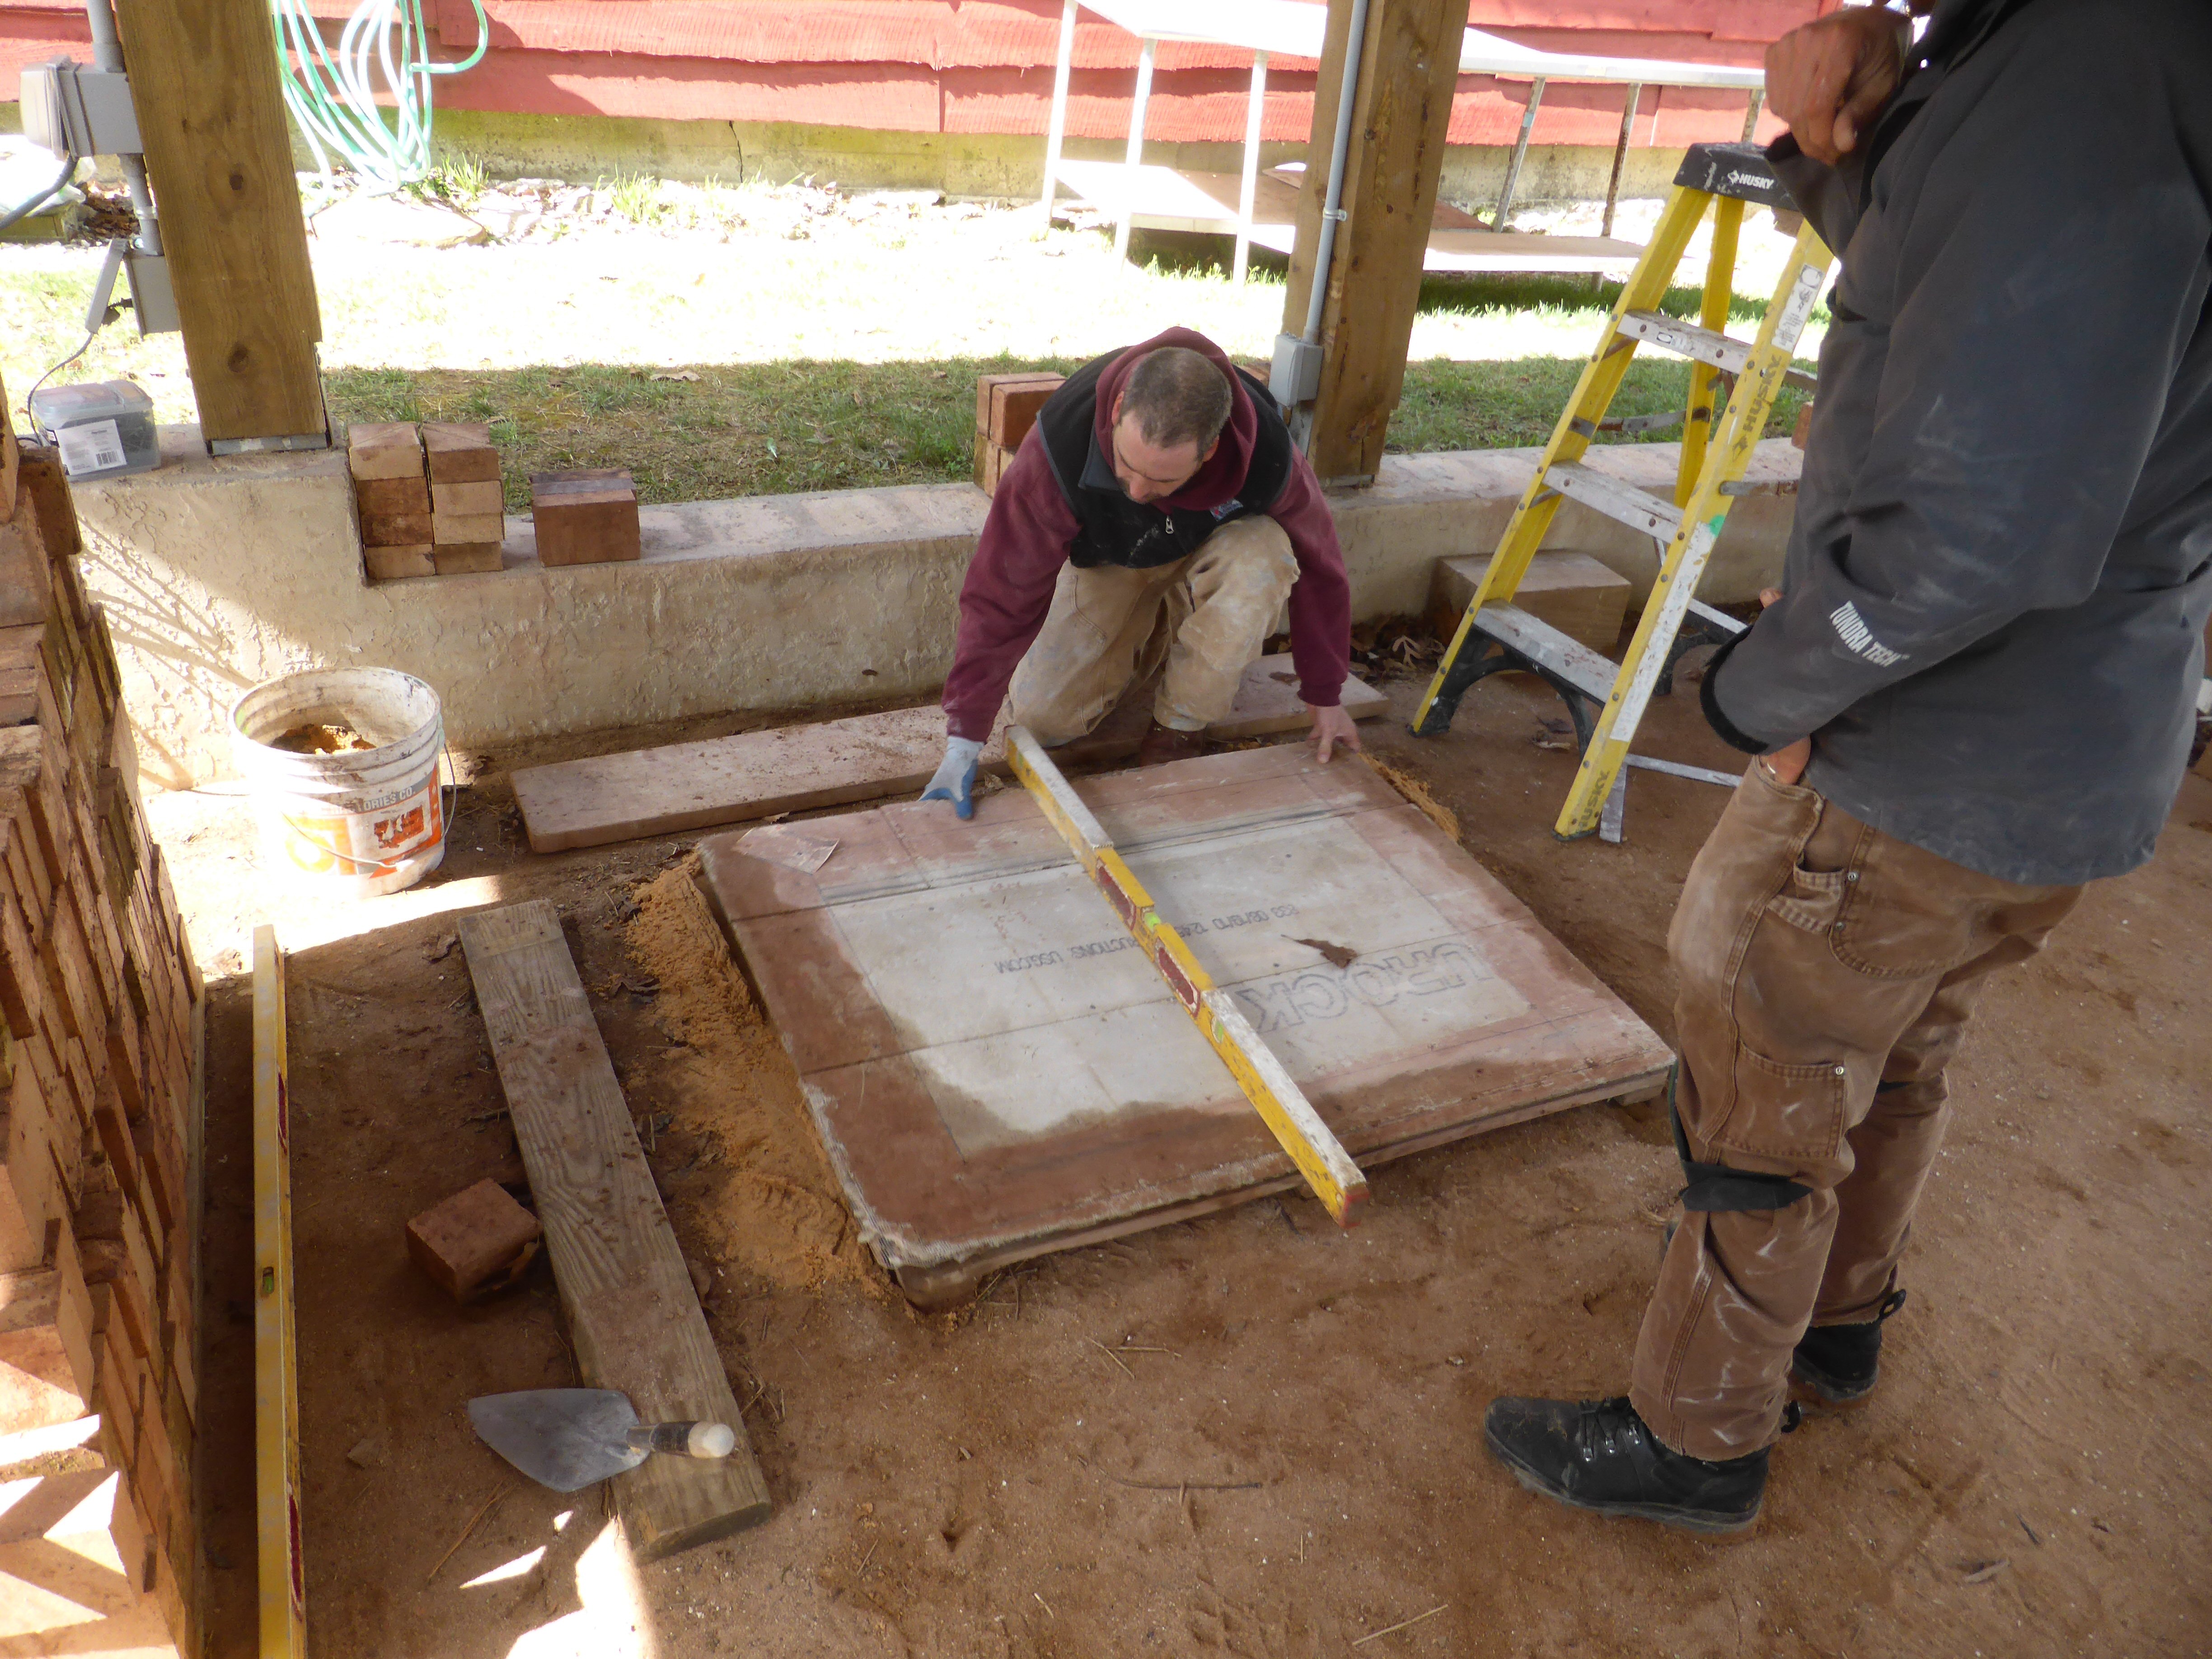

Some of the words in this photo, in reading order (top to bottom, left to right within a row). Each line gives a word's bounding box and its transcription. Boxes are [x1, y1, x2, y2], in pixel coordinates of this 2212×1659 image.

[1739, 173, 1774, 190] HUSKY
[1743, 353, 1783, 432] HUSKY
[1829, 600, 1874, 654] TUNDRA
[1861, 641, 1901, 668] TECH
[1235, 942, 1495, 1034] UROCK
